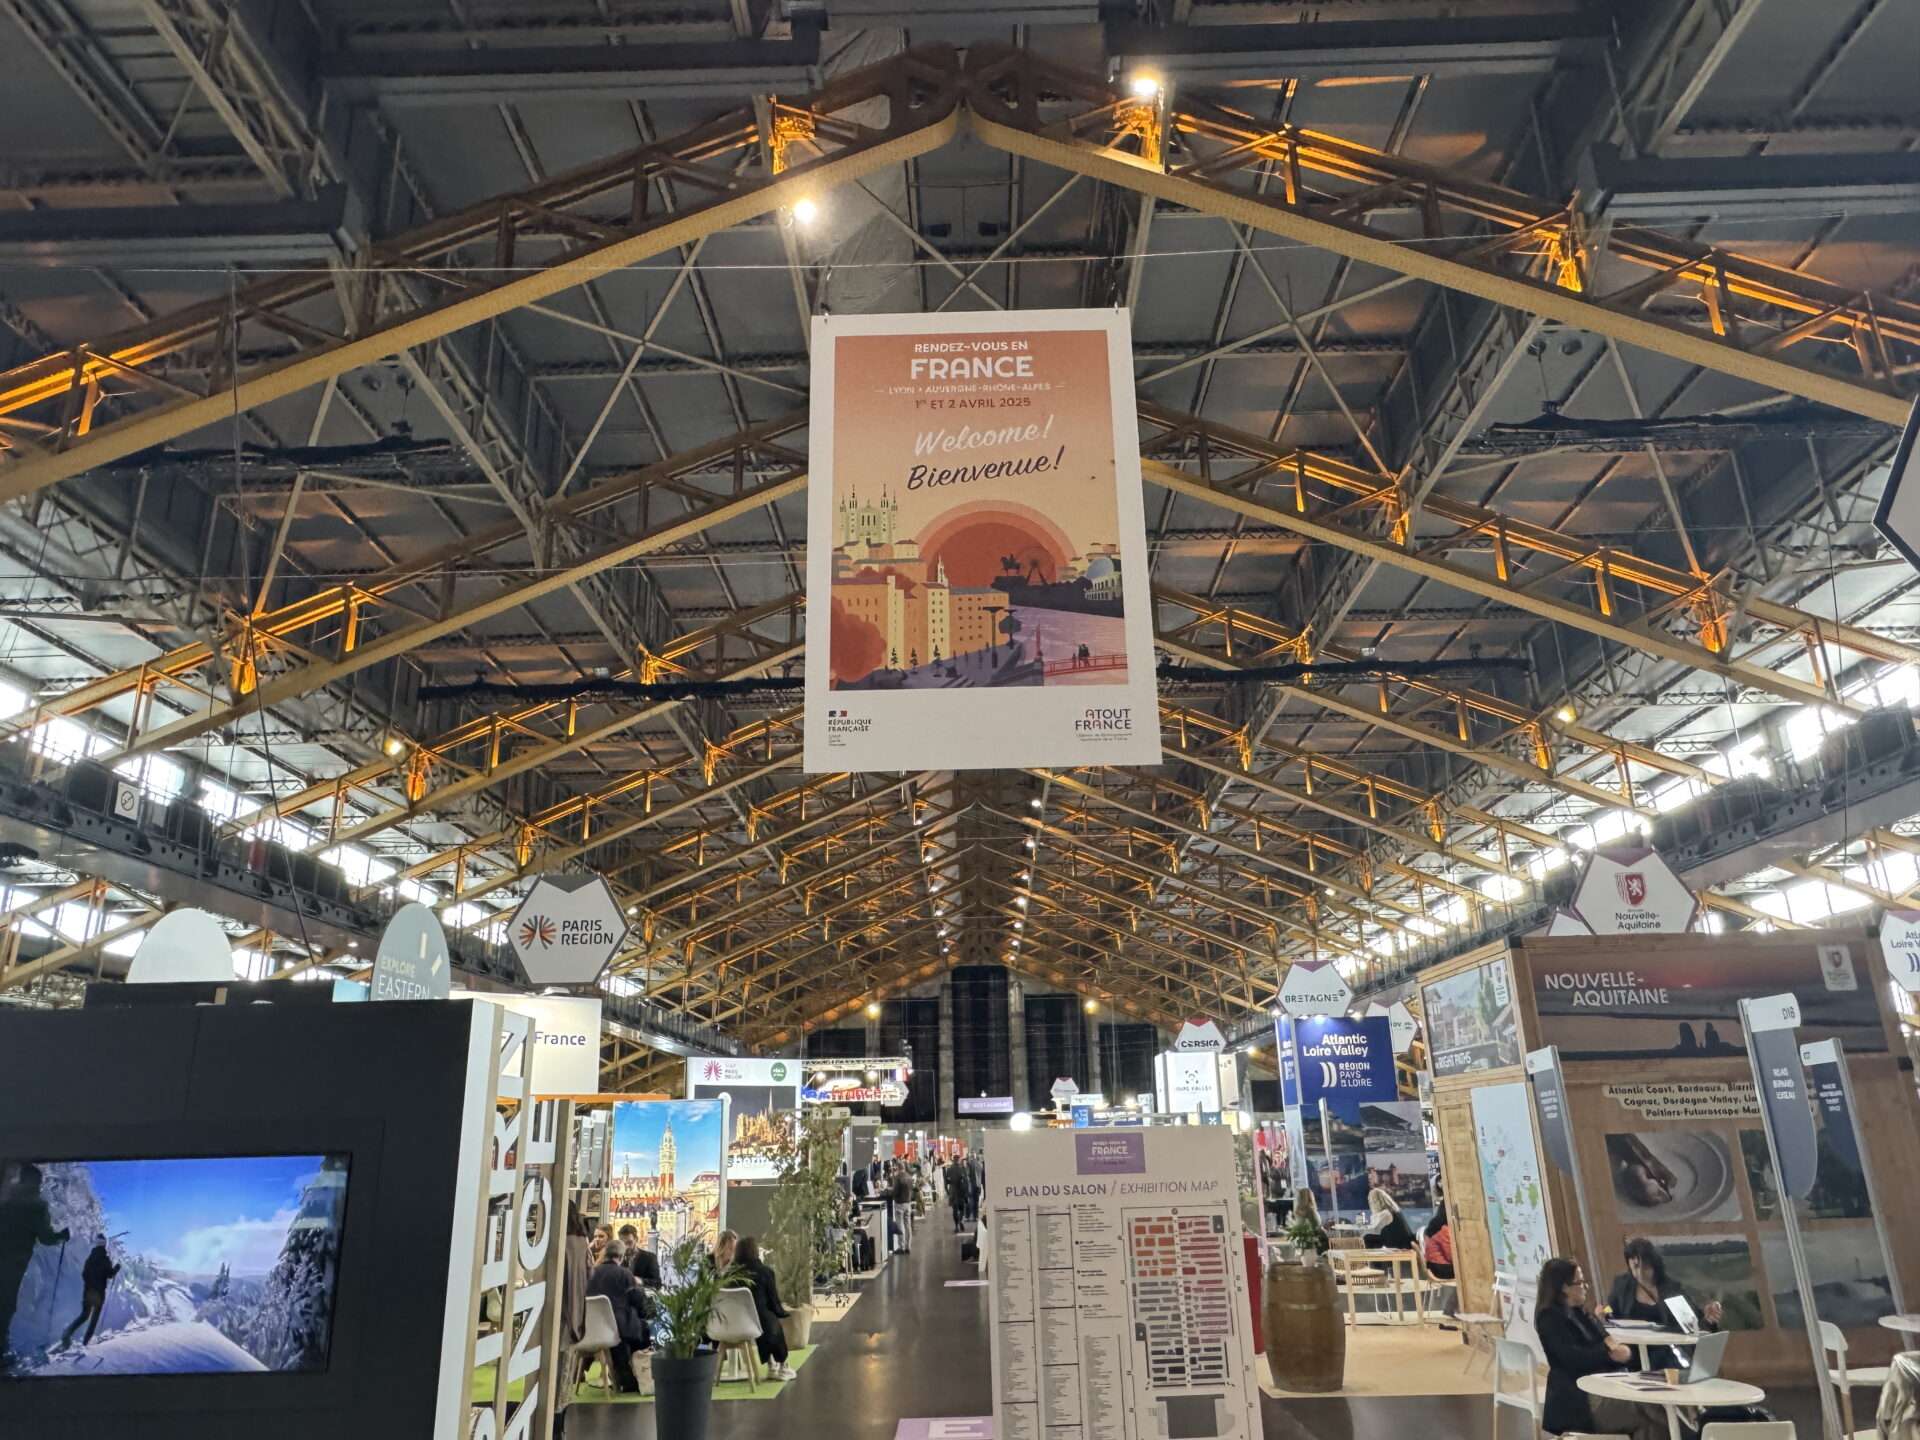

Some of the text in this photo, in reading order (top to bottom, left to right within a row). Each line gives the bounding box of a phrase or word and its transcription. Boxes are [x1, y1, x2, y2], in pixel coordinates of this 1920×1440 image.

[914, 340, 1028, 353] RENDEZ-VOUS EN
[911, 355, 1034, 380] FRANCE
[931, 400, 945, 409] ET
[948, 399, 955, 408] 2
[959, 399, 996, 408] AVRIL
[1000, 397, 1031, 407] 2025
[913, 414, 1054, 456] Welcome!
[907, 445, 1065, 490] Bienvenue!
[1085, 708, 1131, 719] ATOUT
[1075, 719, 1132, 730] FRANCE
[1615, 912, 1660, 920] Nouvelle-
[562, 919, 602, 931] PARIS
[1617, 921, 1661, 931] Aquitaine
[561, 932, 614, 945] REGION
[1544, 971, 1644, 990] NOUVELLE-
[1284, 994, 1339, 1003] BRETAGNE
[1572, 988, 1669, 1007] AQUITAINE
[1321, 1034, 1368, 1045] Atlantic
[1303, 1045, 1369, 1057] Loire Valley
[1339, 1070, 1361, 1078] PAYS
[1348, 1078, 1372, 1087] LOIRE
[1092, 1146, 1128, 1155] FRANCE
[1005, 1184, 1039, 1197] PLAN
[1042, 1184, 1061, 1197] DU
[1063, 1183, 1107, 1196] SALON
[1120, 1181, 1188, 1195] EXHIBITION
[1190, 1180, 1218, 1192] MAP
